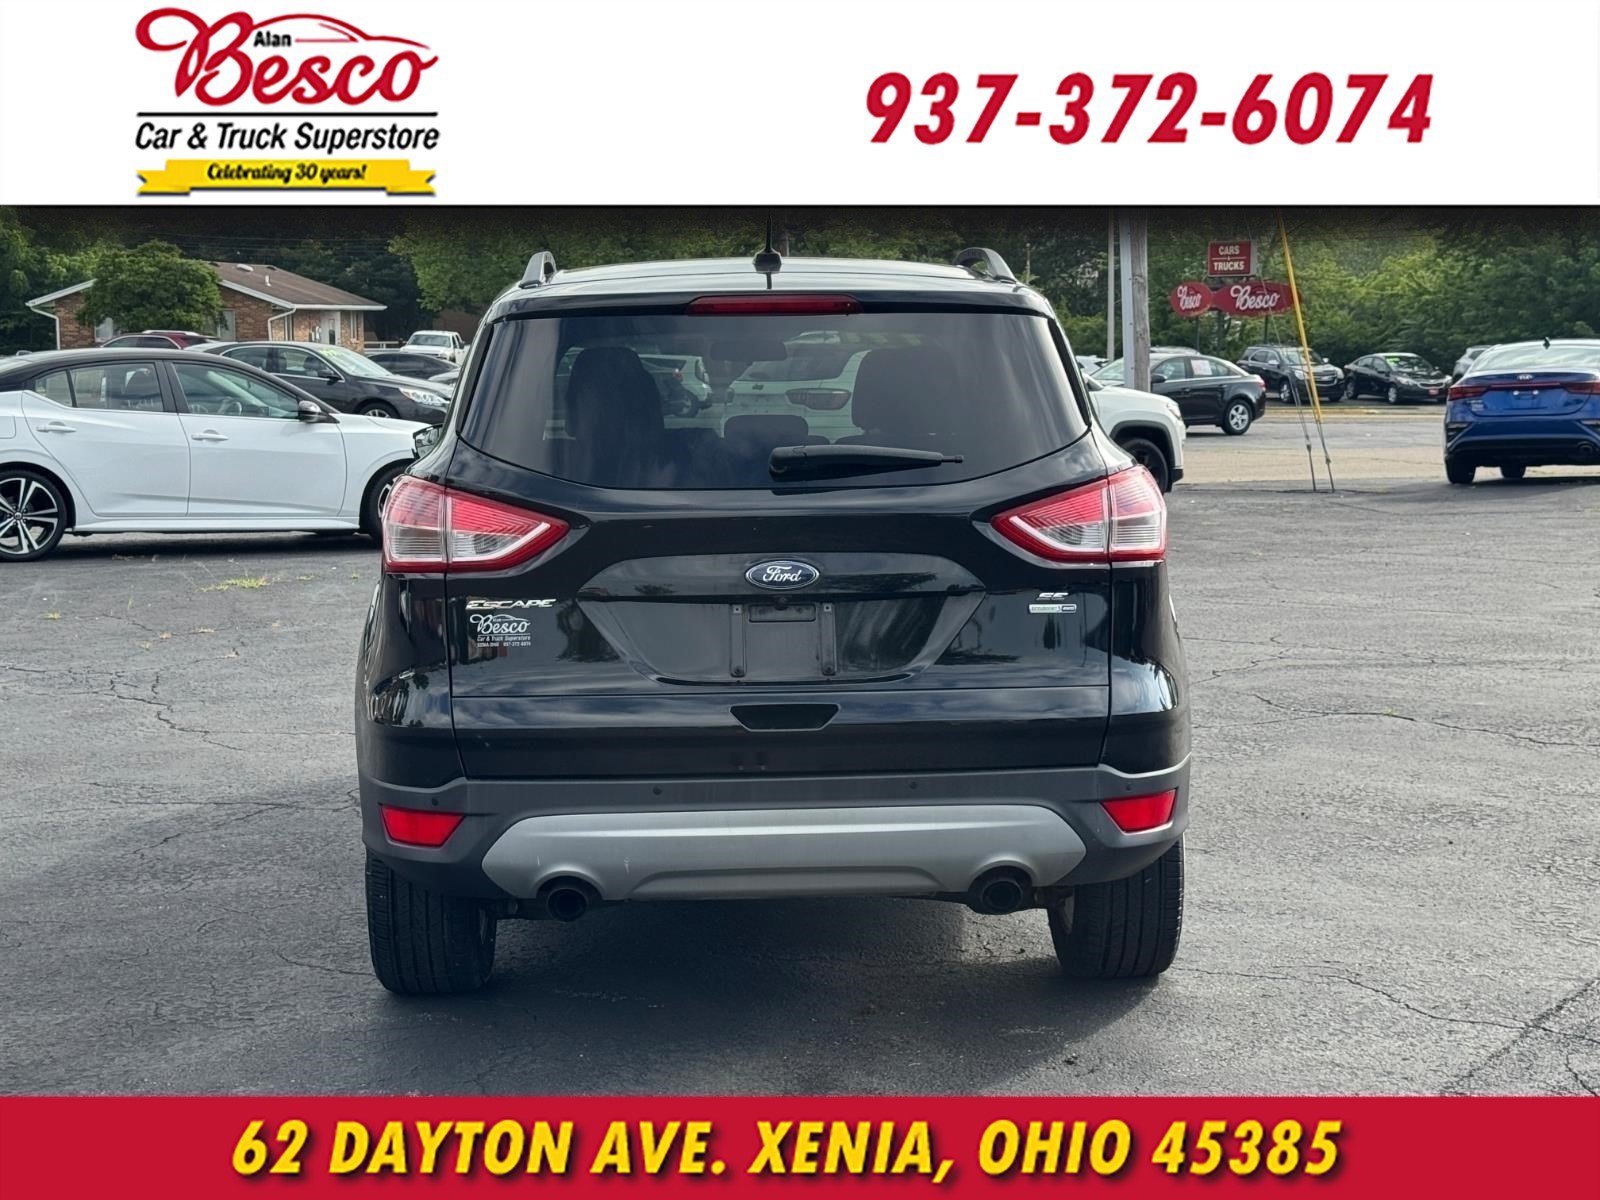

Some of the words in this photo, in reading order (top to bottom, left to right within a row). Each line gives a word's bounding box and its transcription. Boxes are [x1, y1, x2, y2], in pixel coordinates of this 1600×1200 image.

[1218, 245, 1240, 256] CARS
[1213, 260, 1246, 271] TRUCKS
[1230, 285, 1281, 311] Besco
[762, 565, 802, 582] Ford
[465, 598, 557, 610] ESCAPE
[469, 614, 531, 634] Besco
